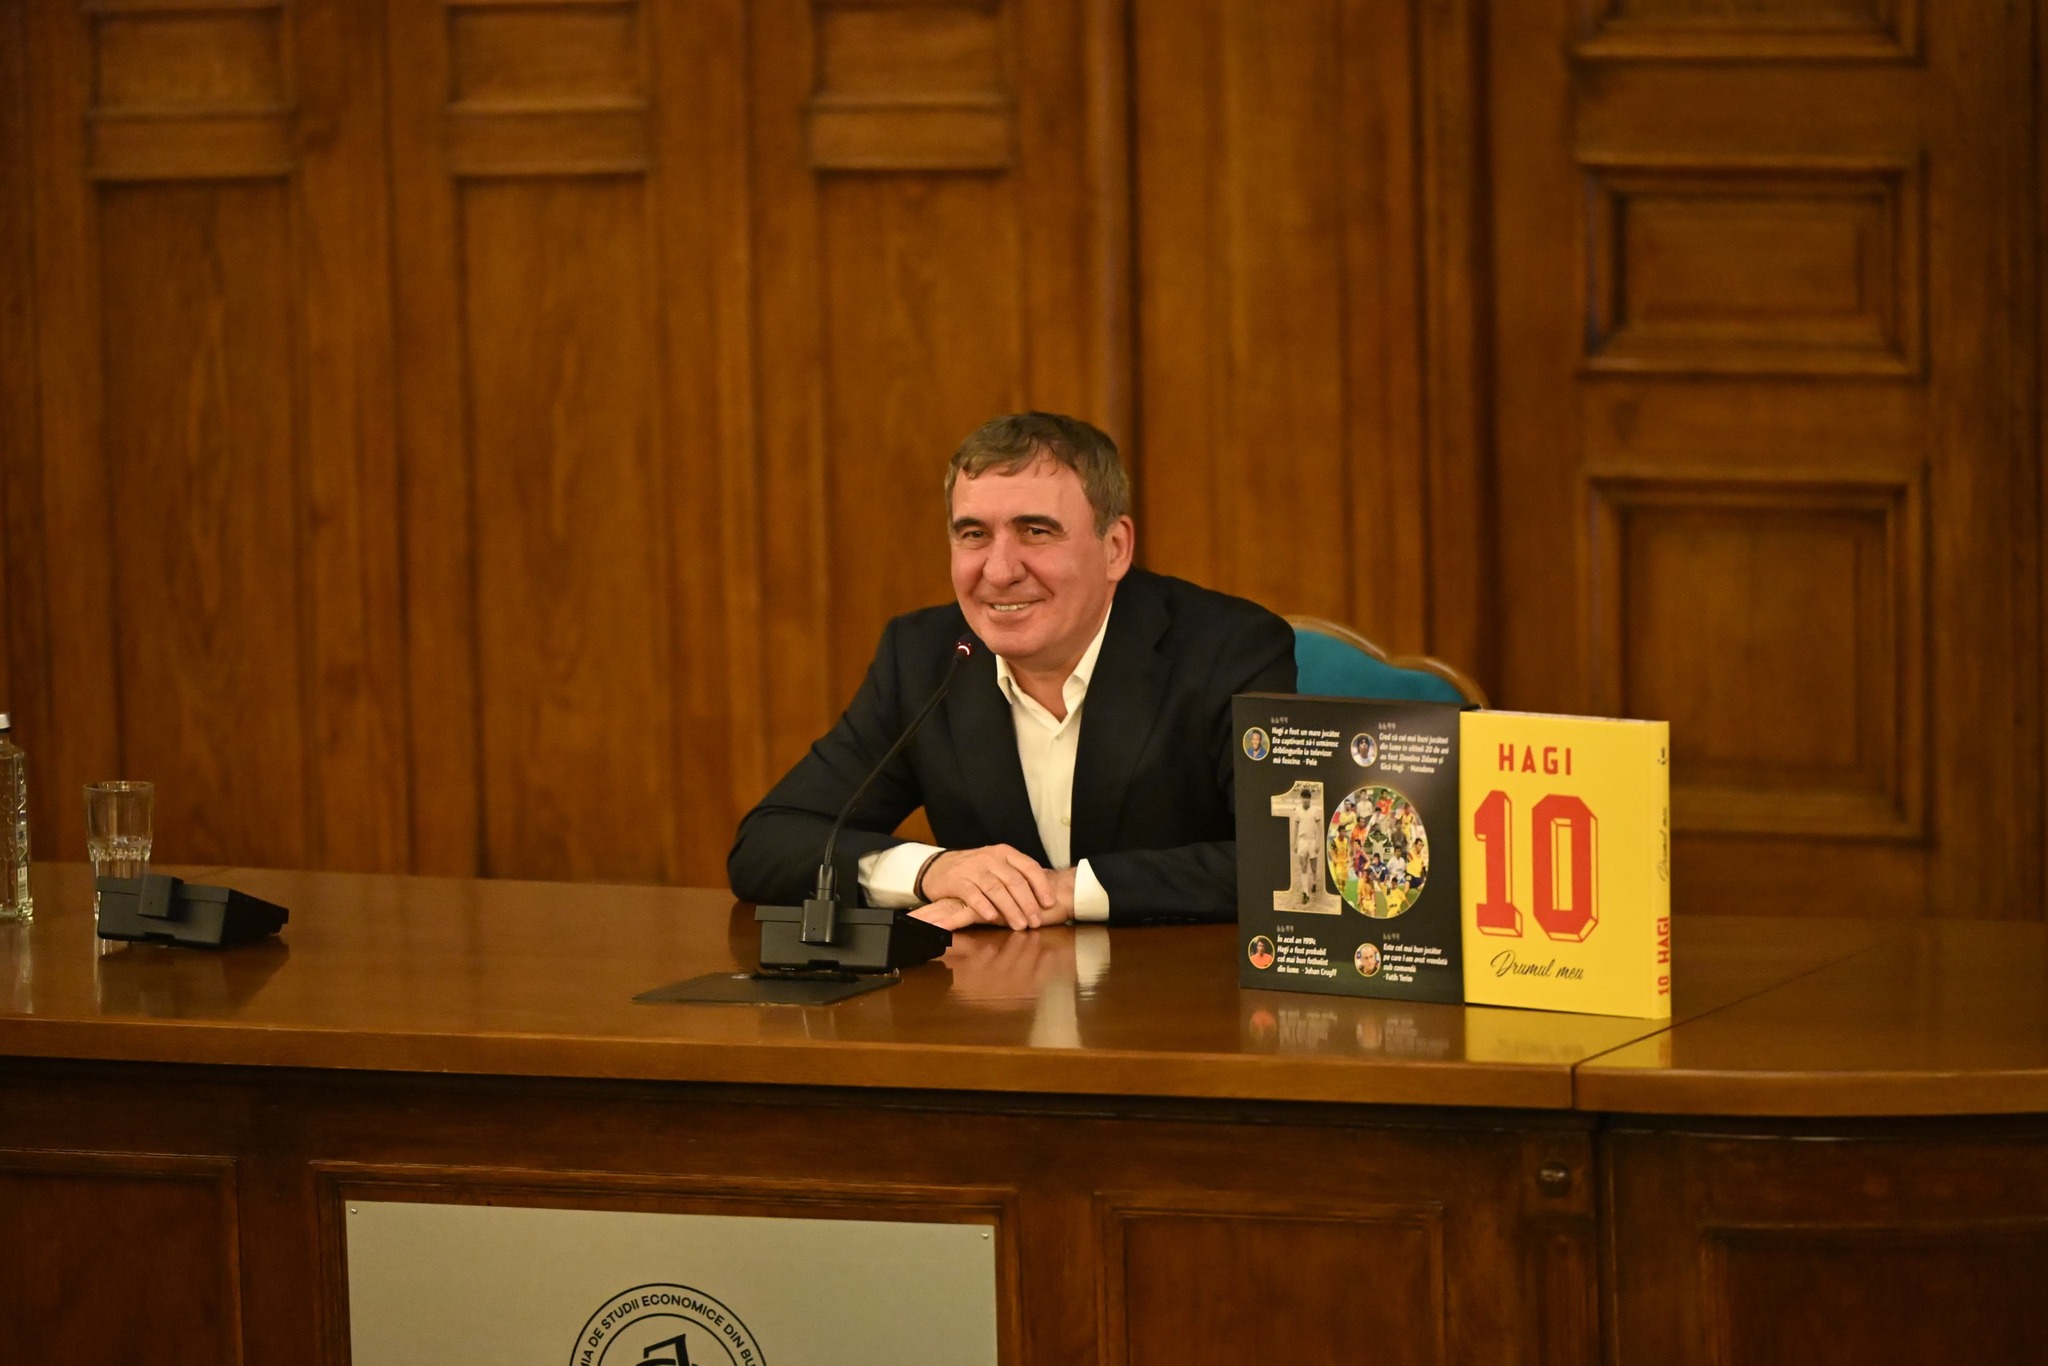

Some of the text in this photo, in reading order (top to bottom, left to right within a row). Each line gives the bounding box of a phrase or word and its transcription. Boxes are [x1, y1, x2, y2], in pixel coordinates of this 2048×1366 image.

[1271, 727, 1284, 737] Hagi
[1289, 727, 1300, 736] fost
[1272, 736, 1281, 744] Era
[1281, 737, 1305, 746] captivant
[1379, 733, 1391, 741] Cred
[1406, 734, 1417, 742] mai
[1380, 742, 1389, 751] din
[1389, 742, 1402, 751] lume
[1433, 745, 1440, 754] de
[1387, 752, 1398, 761] fost
[1498, 743, 1572, 776] HAGI
[1392, 763, 1404, 773] Hagi
[1474, 789, 1599, 943] 10
[1283, 936, 1295, 944] acel
[1277, 945, 1290, 955] Hagi
[1294, 945, 1305, 955] fost
[1383, 943, 1395, 951] Este
[1403, 945, 1413, 953] mai
[1413, 945, 1424, 953] bun
[1285, 956, 1296, 964] mai
[1295, 956, 1307, 964] bun
[1382, 954, 1391, 962] pe
[1656, 916, 1670, 996] 10 HAGI
[1277, 964, 1286, 973] din
[1383, 963, 1393, 971] sub
[1490, 949, 1584, 980] Drumul meu
[587, 1328, 605, 1348] DE
[601, 1298, 640, 1330] STUDII
[641, 1293, 725, 1327] ECONOMICE
[722, 1323, 745, 1349] DIN
